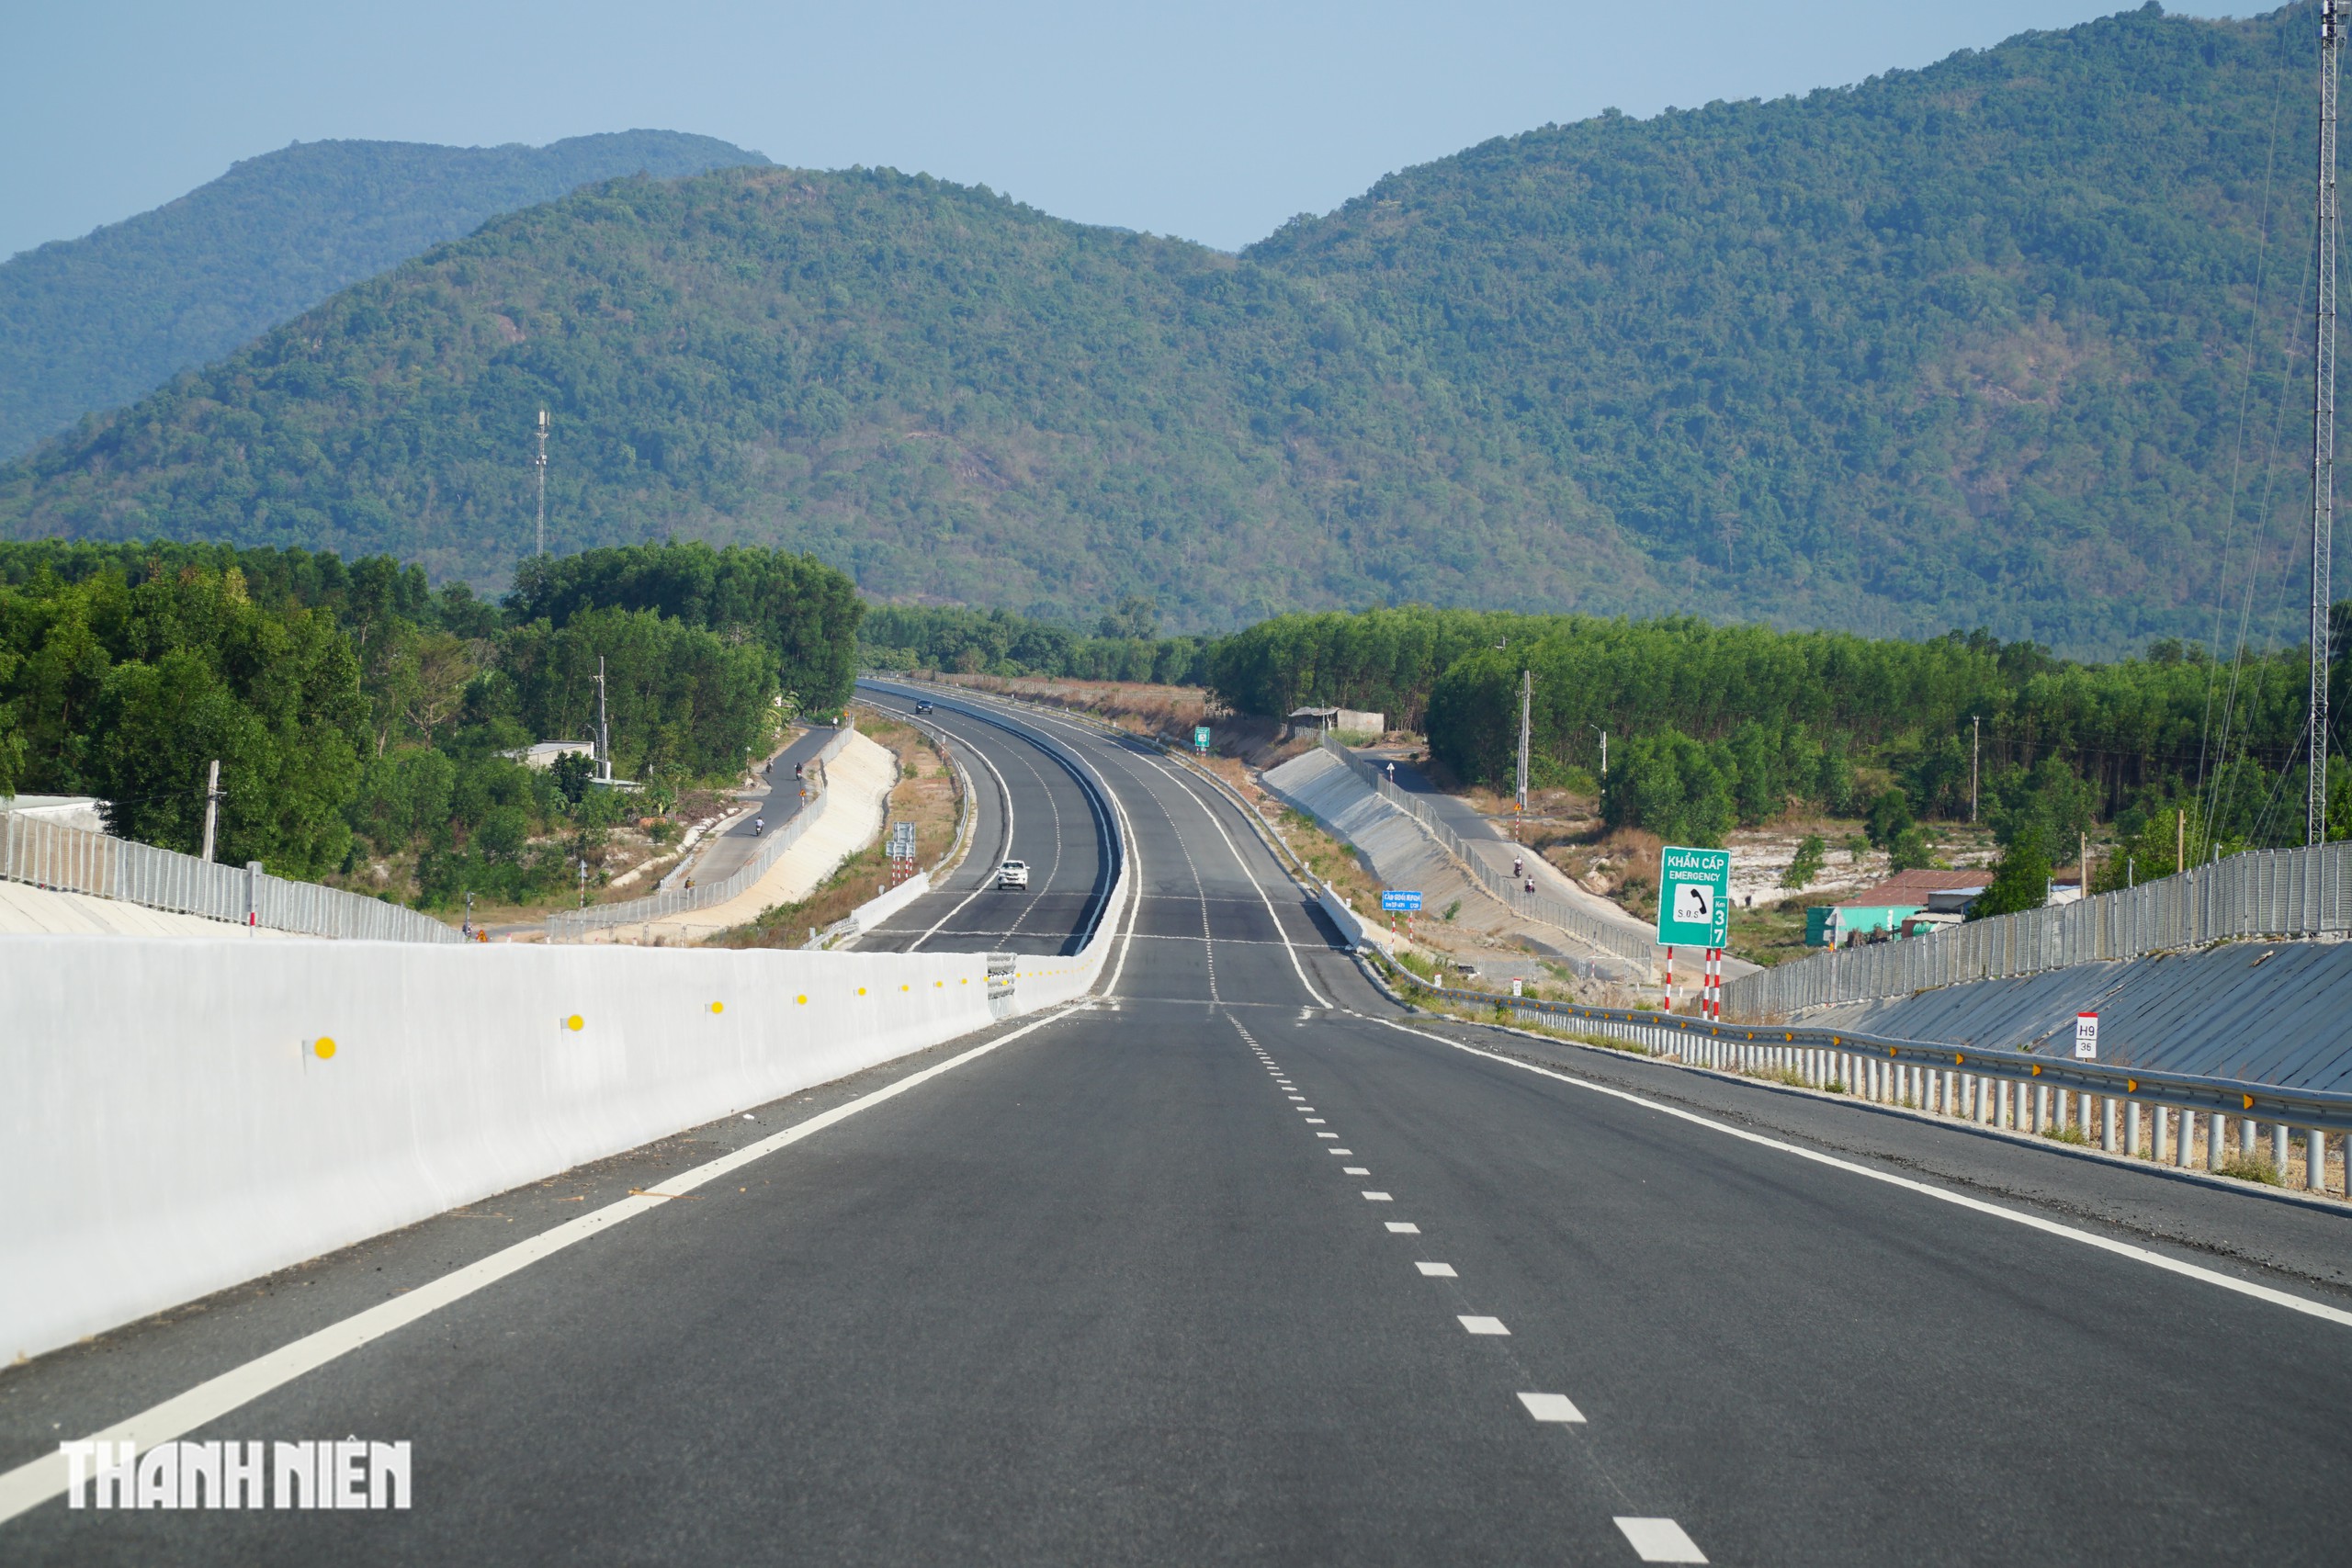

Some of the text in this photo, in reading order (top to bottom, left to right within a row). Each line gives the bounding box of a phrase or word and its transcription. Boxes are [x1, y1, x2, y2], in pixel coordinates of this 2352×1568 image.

[1668, 852, 1724, 870] KHẨN CẤP
[1669, 870, 1721, 882] EMERGENCY
[1714, 900, 1725, 908] Km
[2079, 1024, 2095, 1037] H9
[2080, 1042, 2092, 1052] 36
